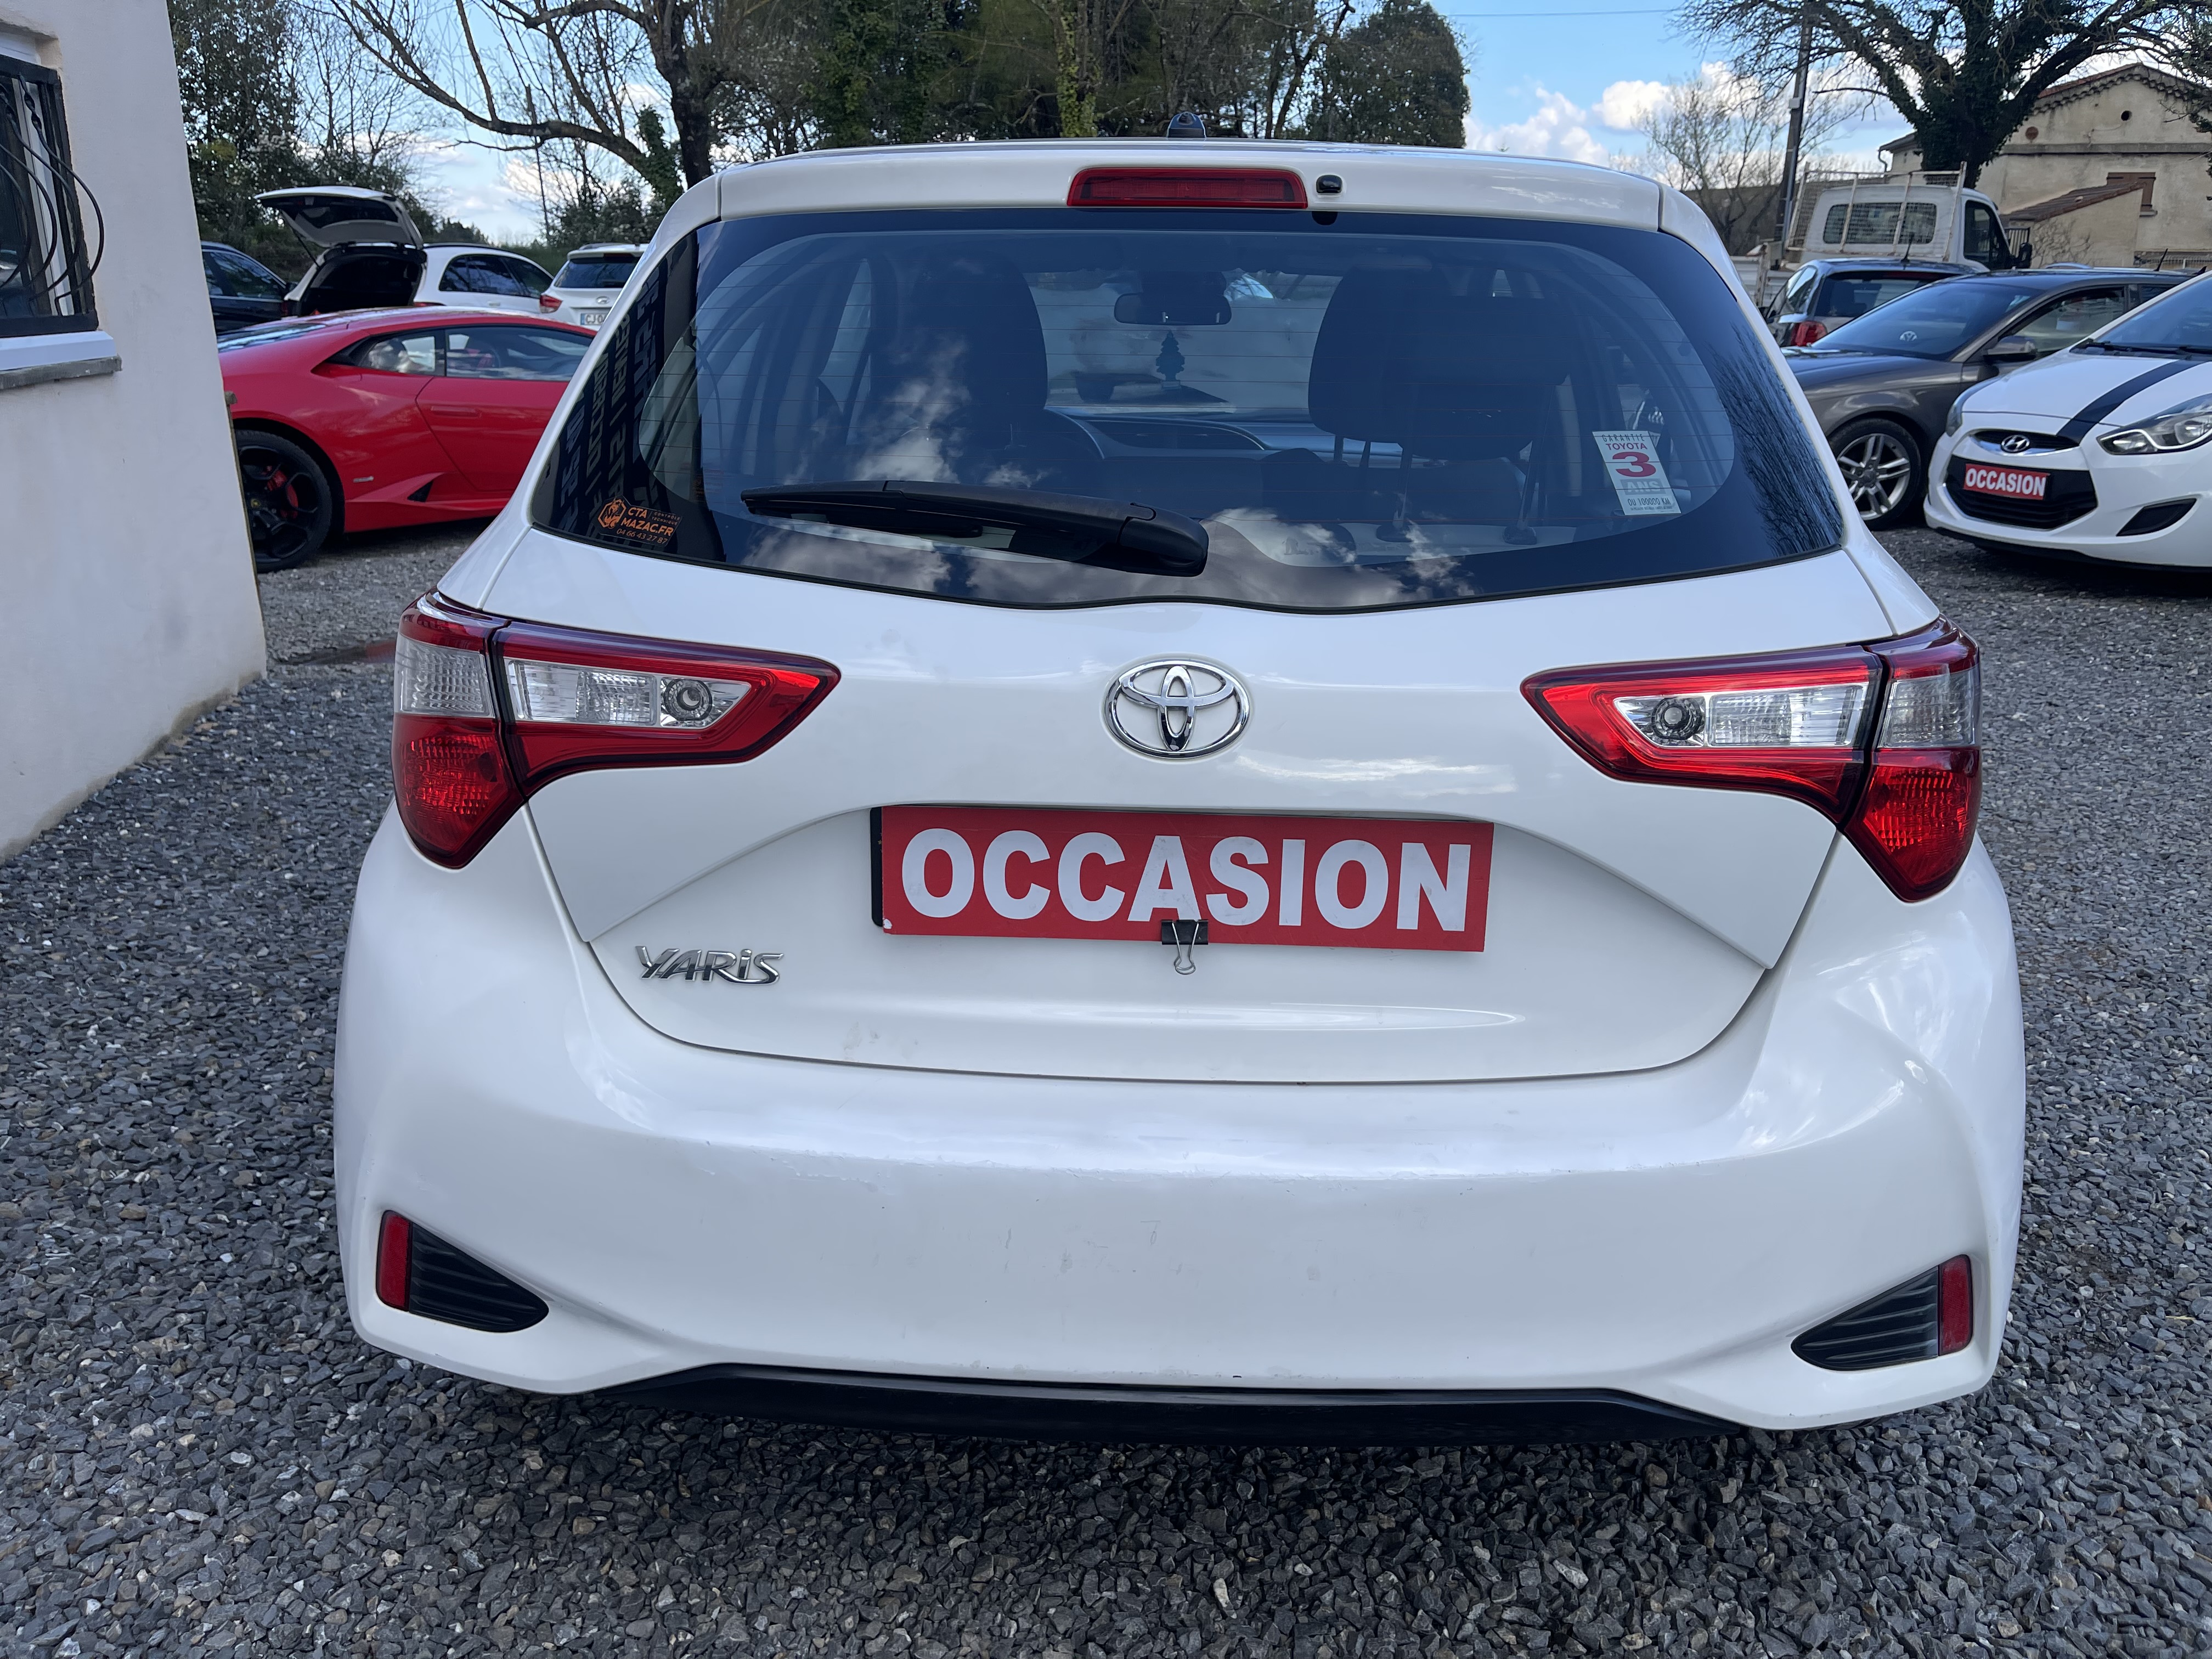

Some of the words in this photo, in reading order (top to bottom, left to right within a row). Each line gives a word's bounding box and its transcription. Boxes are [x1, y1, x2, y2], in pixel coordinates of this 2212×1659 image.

[1601, 434, 1645, 442] GARANTIE
[1612, 452, 1656, 477] 3
[1627, 481, 1661, 493] ANS
[1965, 468, 2046, 496] OCCASION
[1627, 498, 1637, 506] OU
[1637, 498, 1661, 506] 100000
[1661, 497, 1672, 505] KM
[628, 507, 647, 518] CTA
[620, 517, 674, 536] MAZAC.FR
[652, 517, 678, 526] TECHNIQUE
[901, 827, 1471, 932] OCCASION
